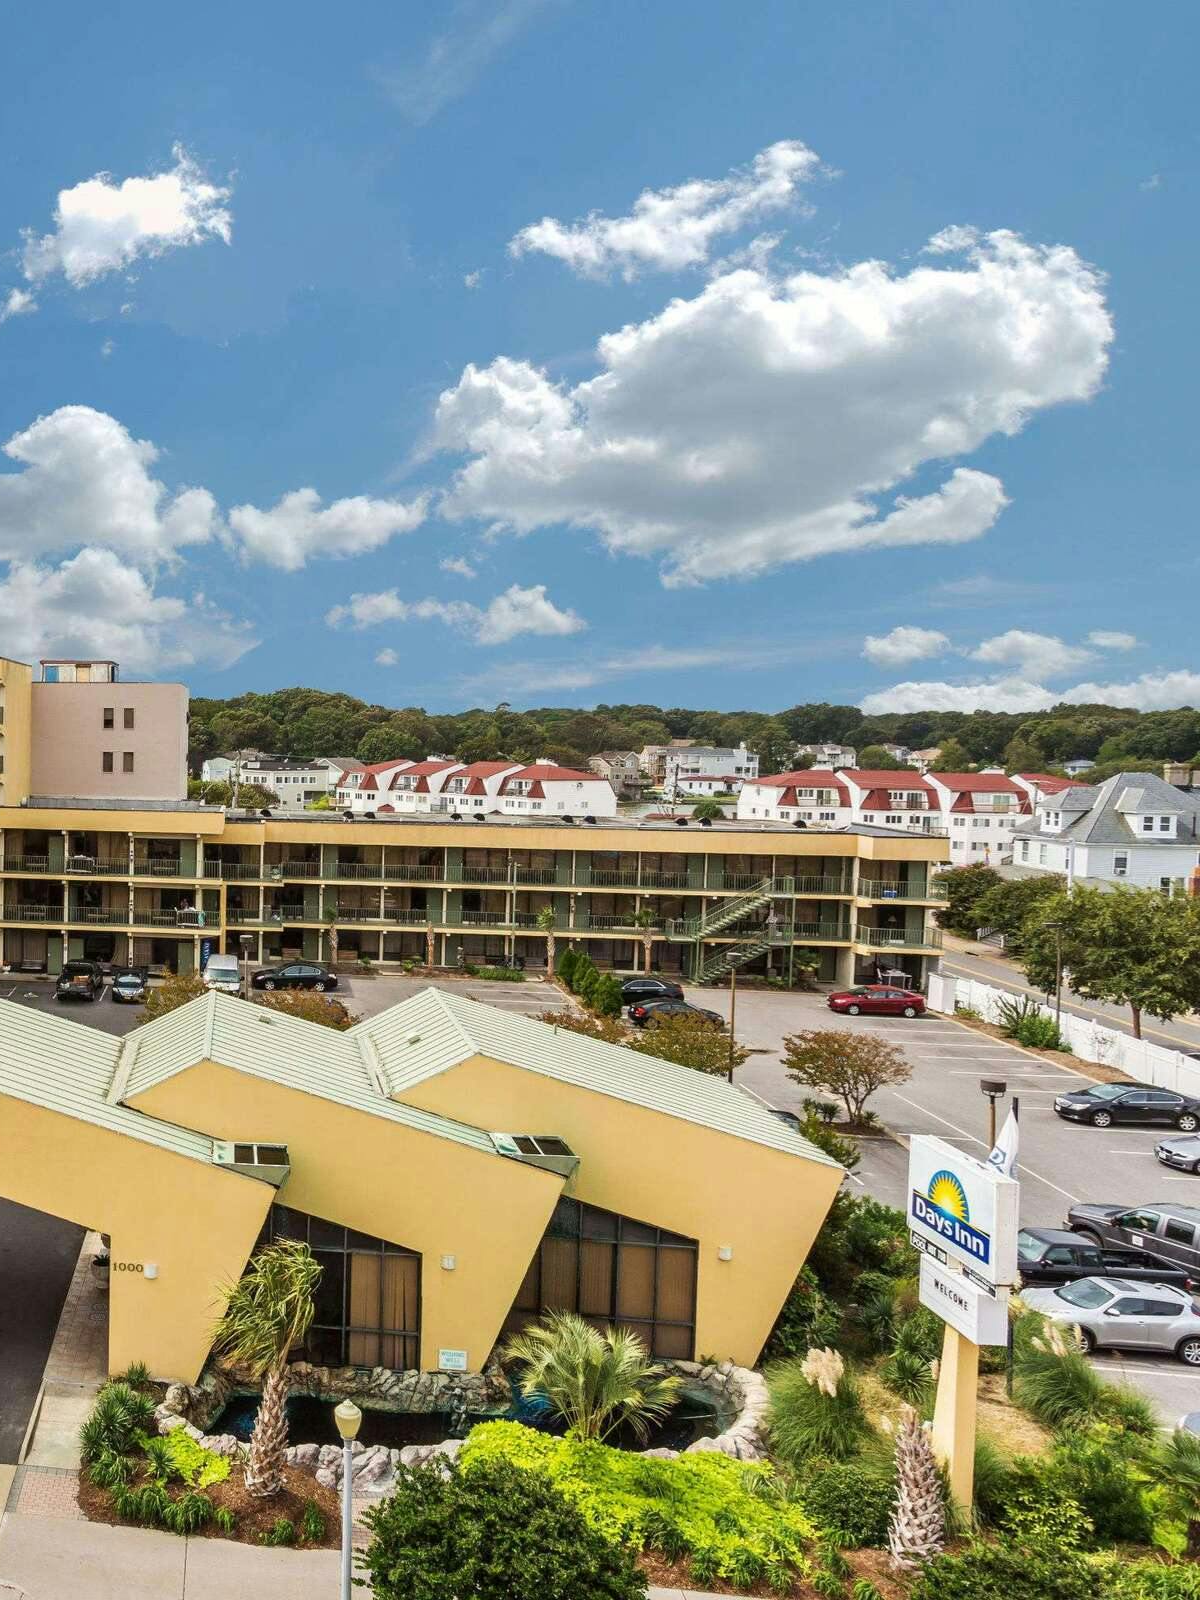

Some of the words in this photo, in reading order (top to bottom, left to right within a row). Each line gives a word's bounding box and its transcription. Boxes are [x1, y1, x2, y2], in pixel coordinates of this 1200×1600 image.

[915, 1195, 953, 1236] Days
[955, 1221, 985, 1258] Inn
[113, 1262, 144, 1273] 1000
[934, 1279, 969, 1312] WELCOME
